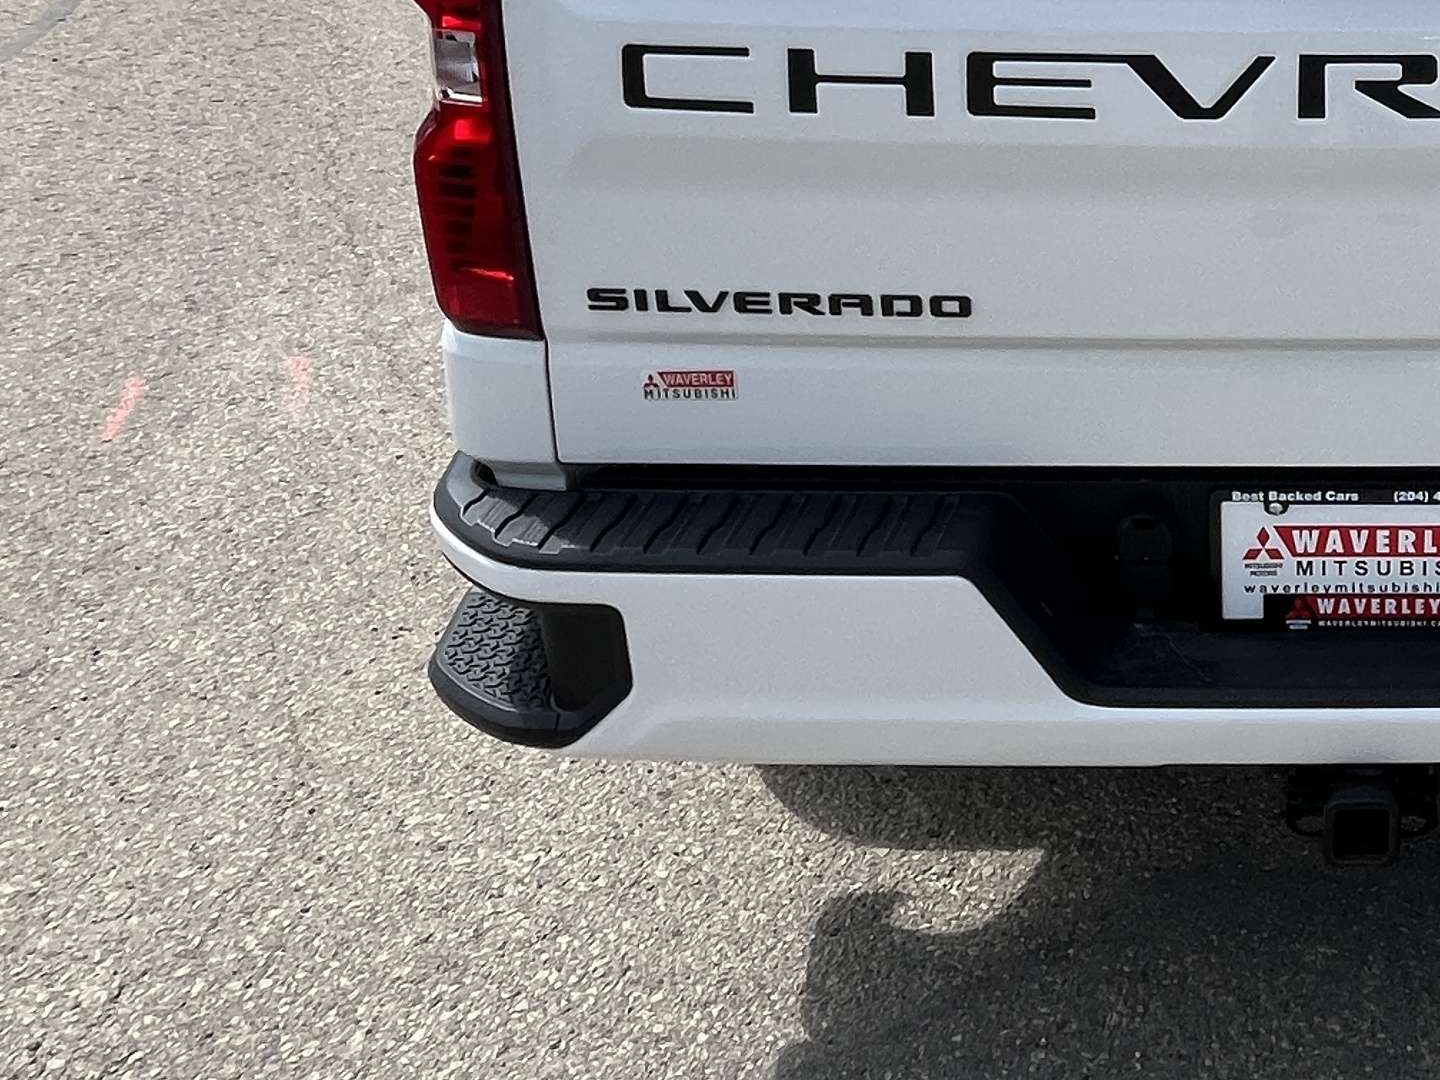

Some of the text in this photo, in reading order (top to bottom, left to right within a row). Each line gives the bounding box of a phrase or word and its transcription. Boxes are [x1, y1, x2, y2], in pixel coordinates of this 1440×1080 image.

[586, 287, 972, 318] SILVERADO
[663, 373, 732, 386] WAVERLEY
[644, 388, 736, 400] MITSUBISHI
[1232, 491, 1359, 502] Best Backed Cars
[1394, 491, 1429, 502] (204)
